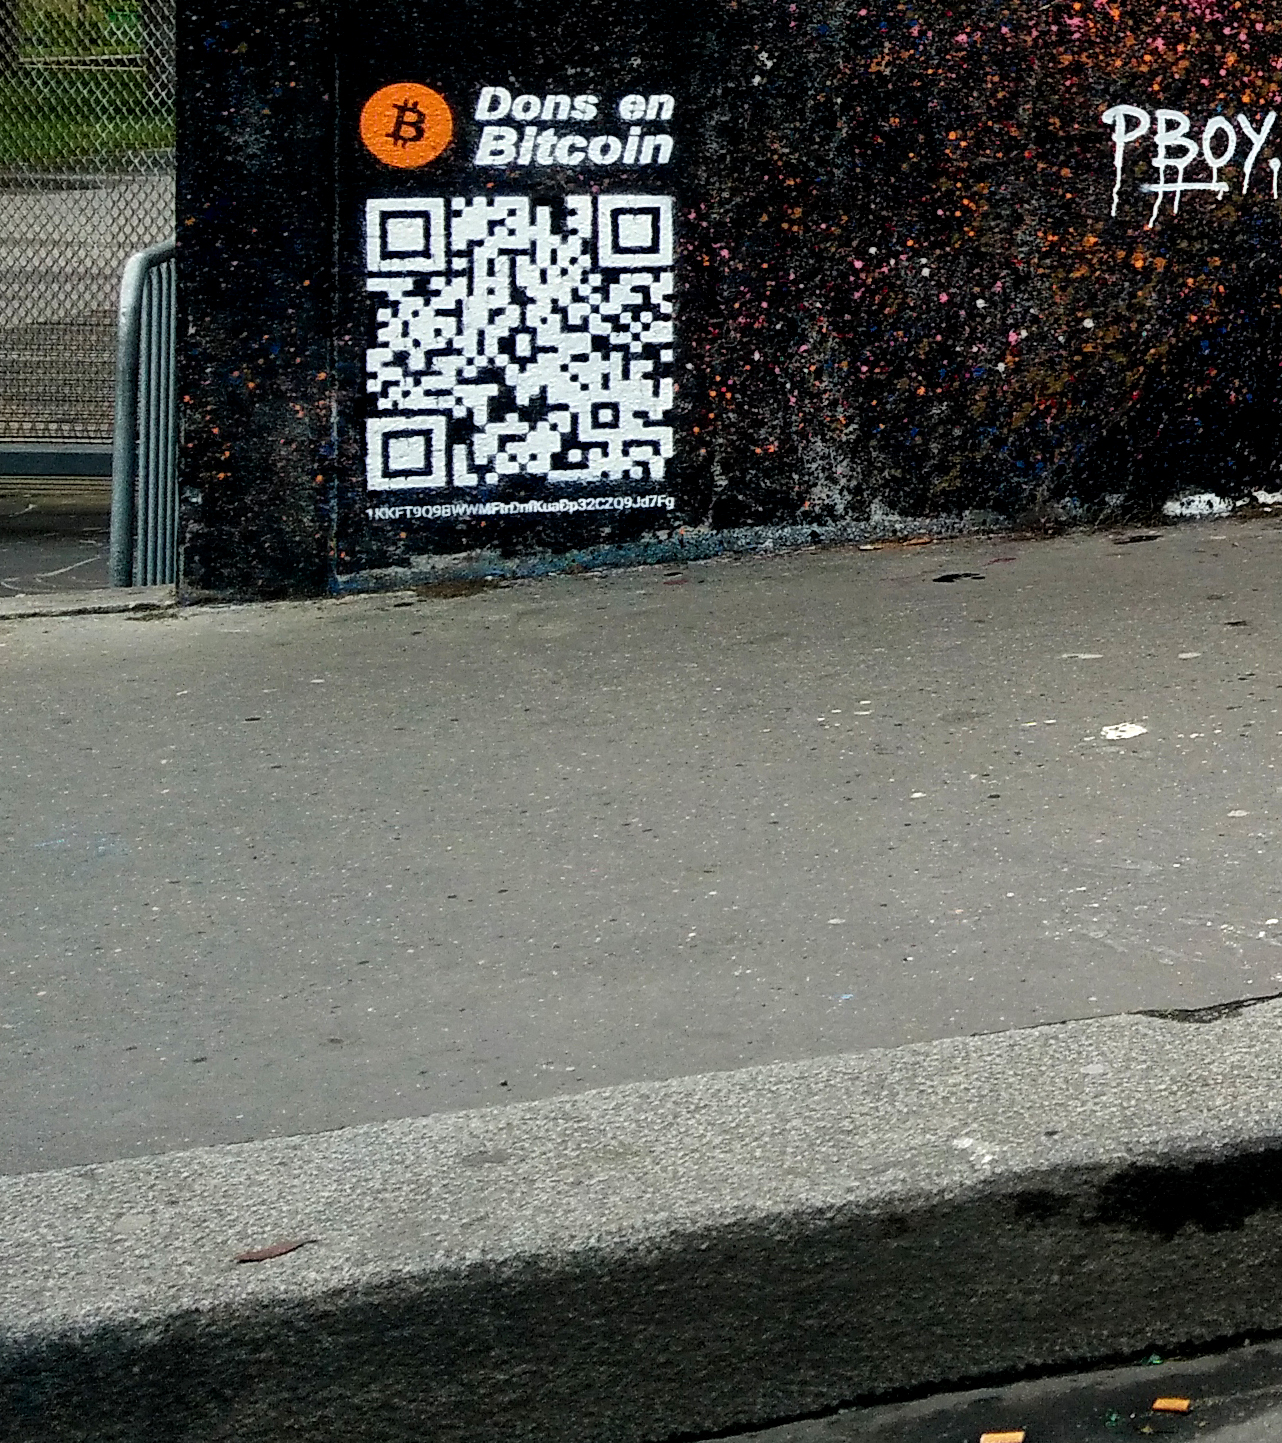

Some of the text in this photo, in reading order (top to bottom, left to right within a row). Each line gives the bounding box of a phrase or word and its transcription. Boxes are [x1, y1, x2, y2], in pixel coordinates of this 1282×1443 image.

[474, 87, 676, 121] Dons en
[474, 126, 675, 166] Bitcoin
